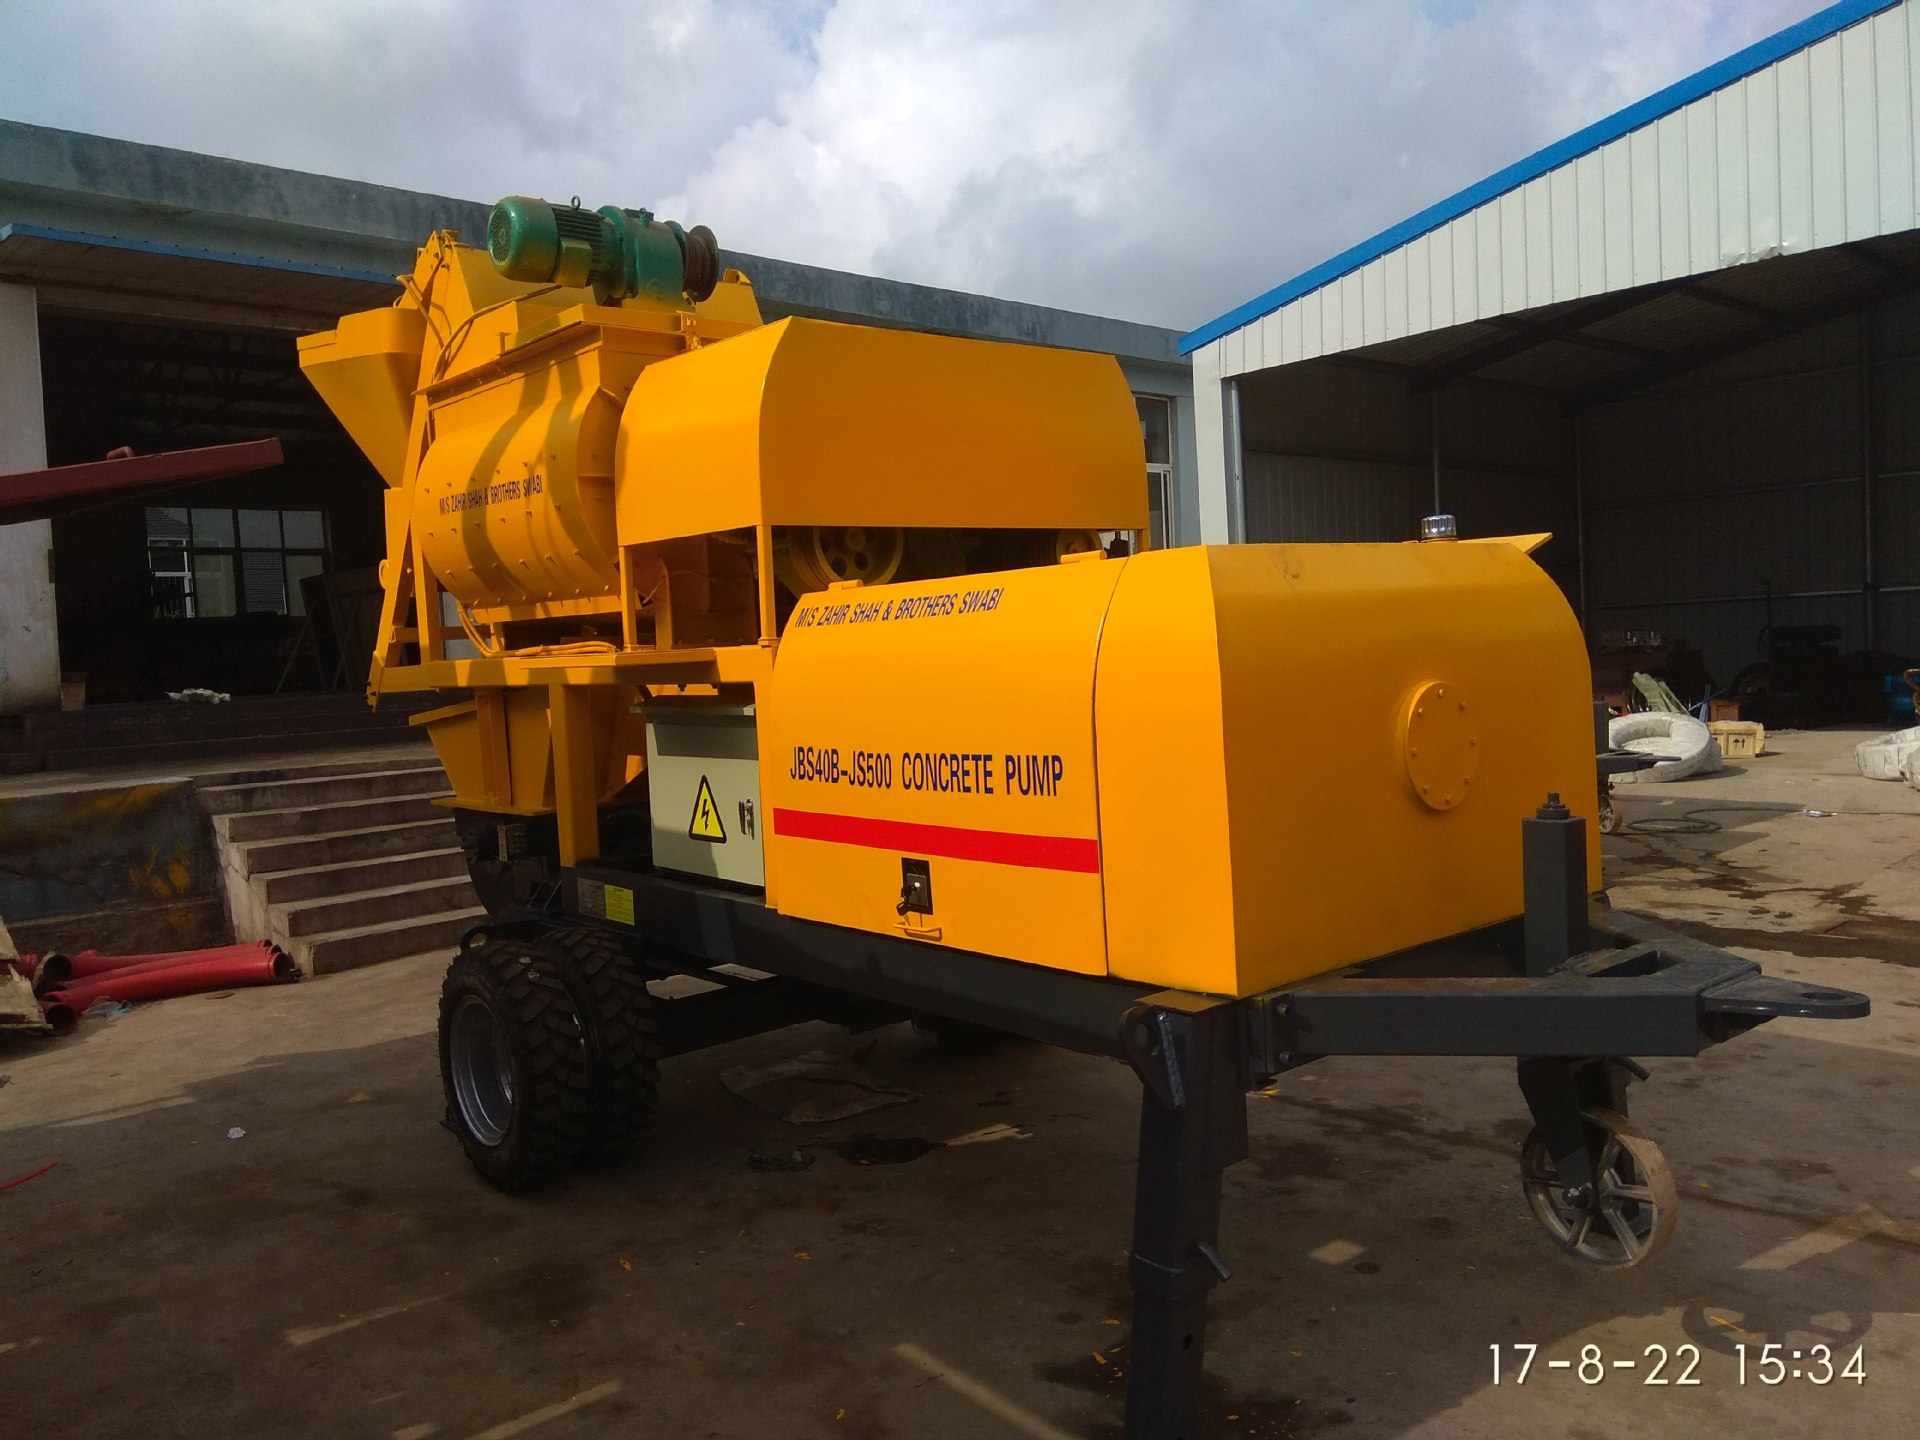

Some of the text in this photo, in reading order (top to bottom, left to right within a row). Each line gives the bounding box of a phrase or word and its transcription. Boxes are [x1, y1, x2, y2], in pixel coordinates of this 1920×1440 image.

[451, 493, 467, 512] ZAHIR
[467, 489, 483, 510] SHAH
[491, 480, 521, 504] BROTHERS
[523, 475, 543, 498] SWABI
[817, 603, 851, 627] ZAHIR
[849, 600, 884, 624] SHAH
[882, 599, 894, 621] &
[894, 593, 959, 620] BROTHERS
[958, 587, 1005, 614] SWABI
[790, 746, 1063, 797] JBS40B-JS500 CONCRETE PUMP
